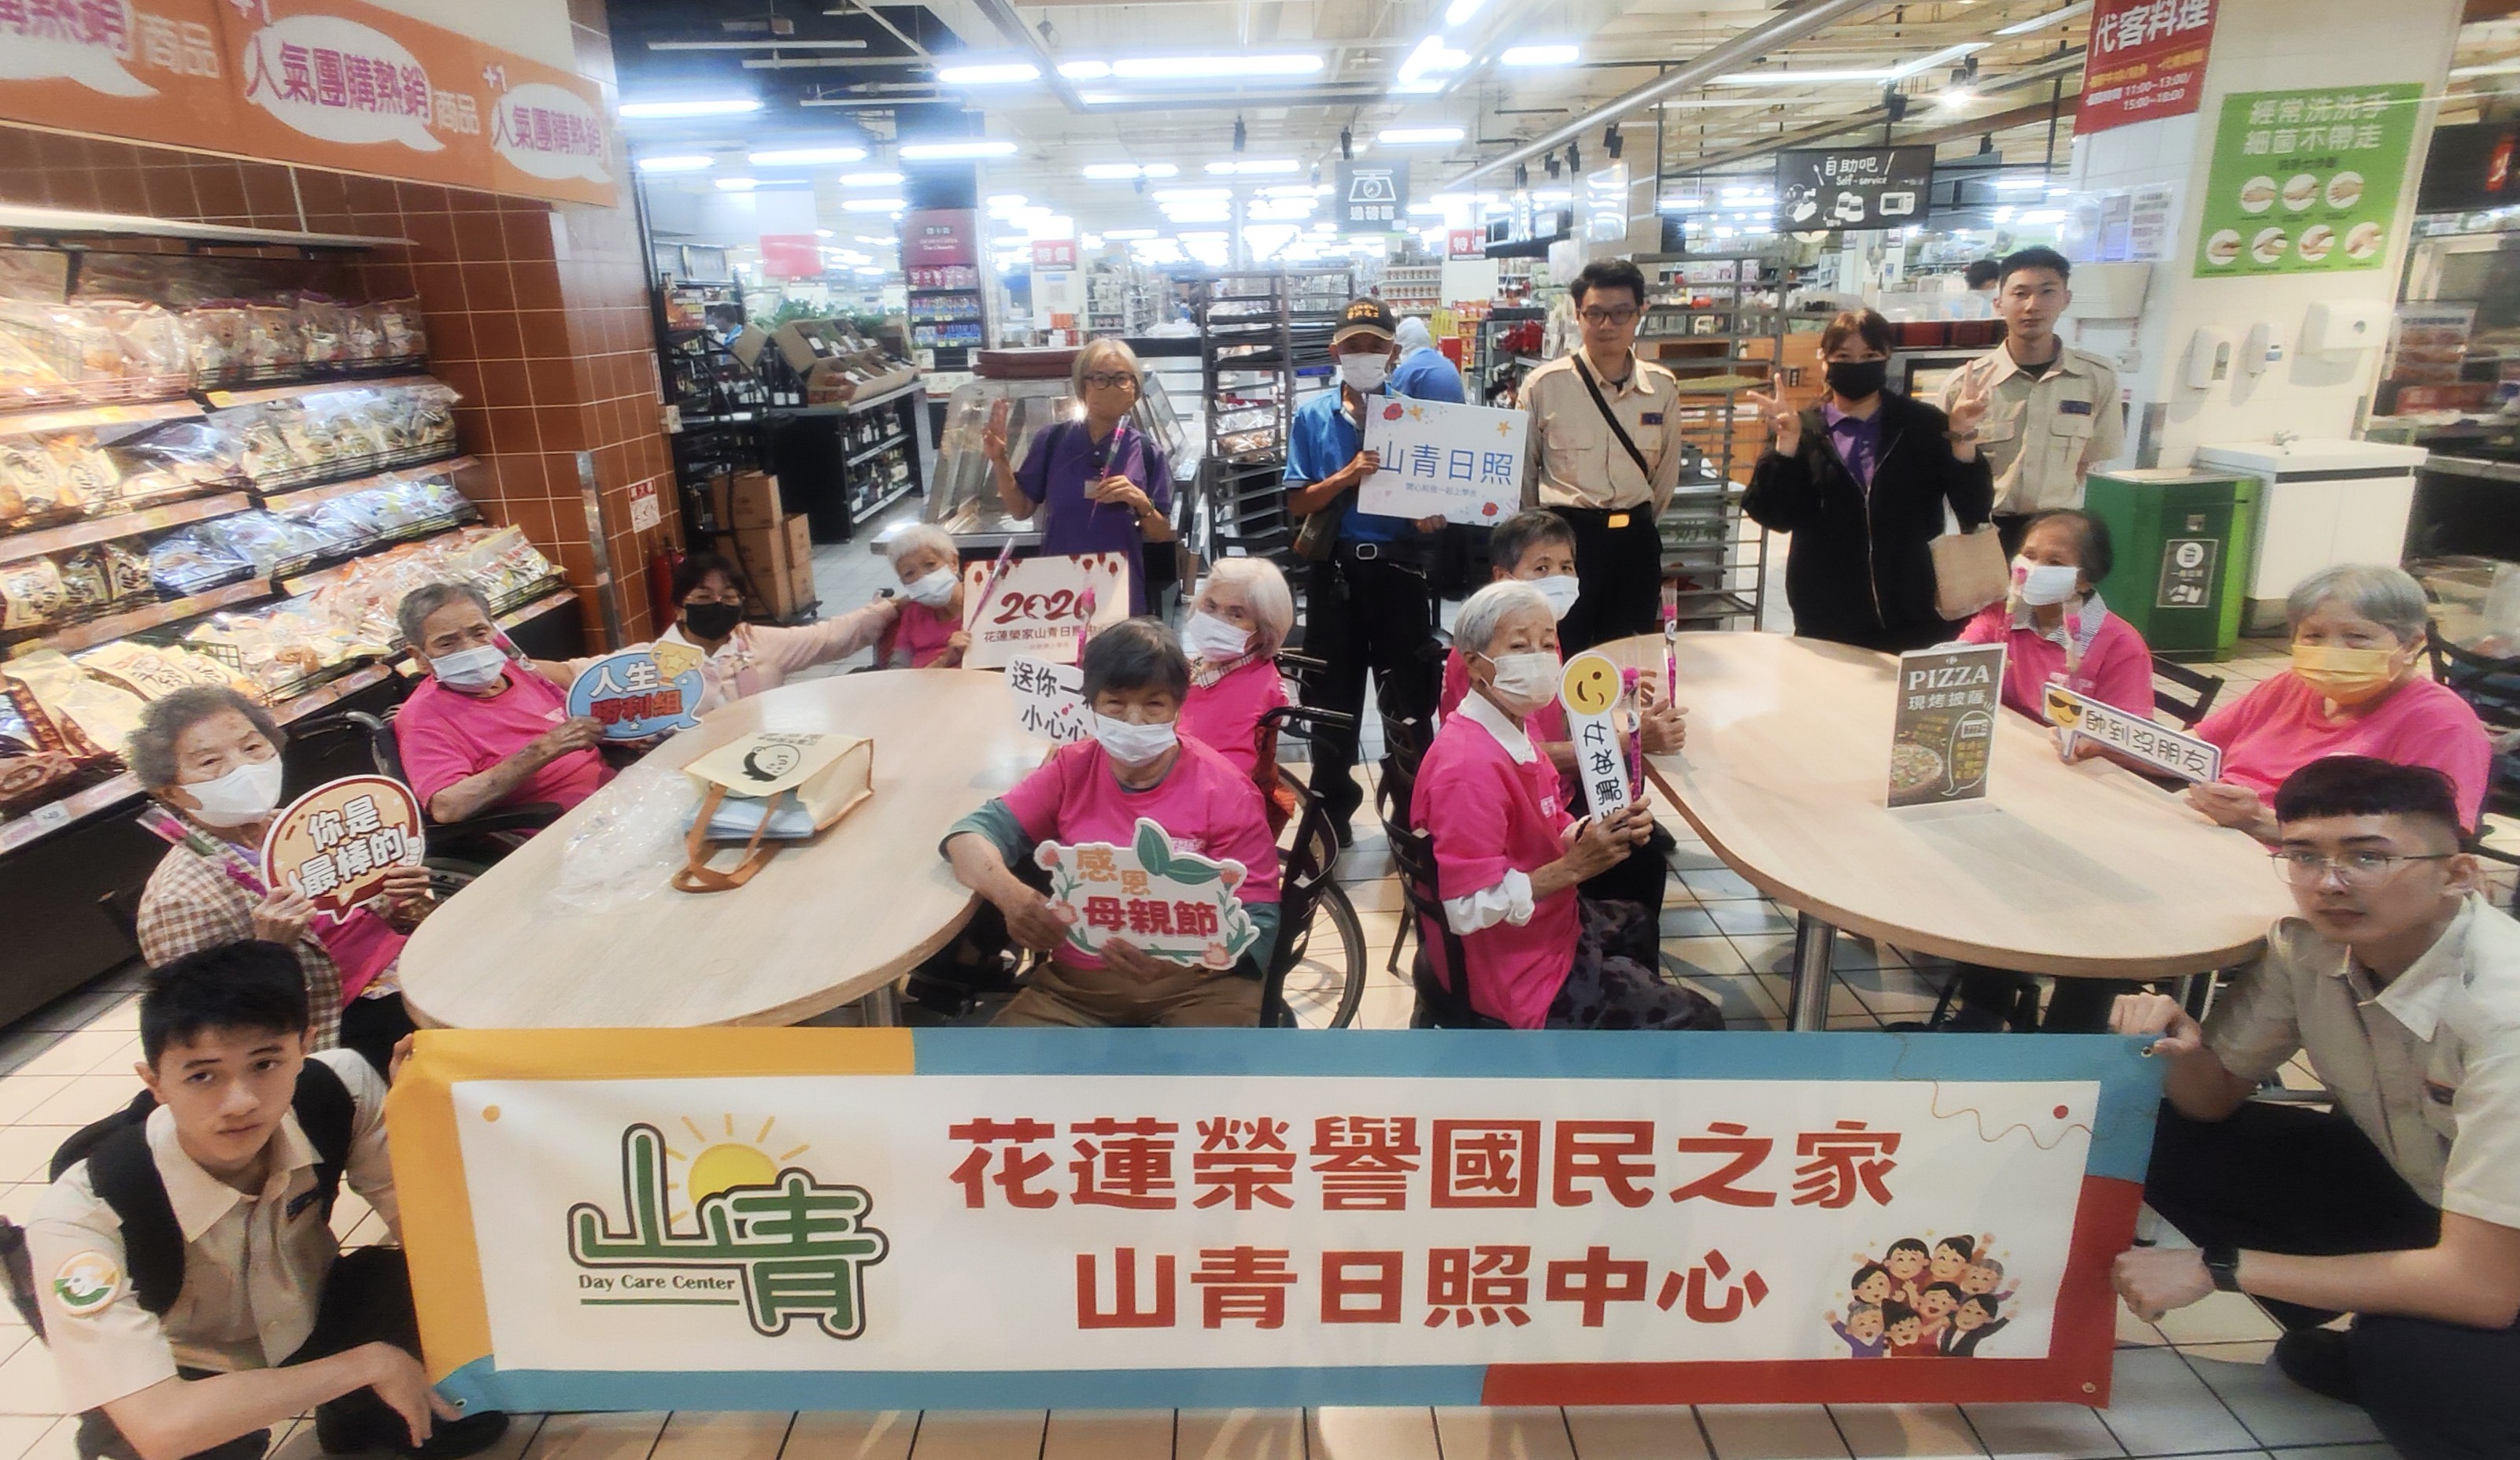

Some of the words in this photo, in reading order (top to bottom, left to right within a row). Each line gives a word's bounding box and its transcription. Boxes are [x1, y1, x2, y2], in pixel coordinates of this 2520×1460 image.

[137, 12, 220, 79] 商品
[2093, 0, 2211, 57] 代客料理
[246, 35, 430, 118] 人氣團購熱銷
[434, 89, 480, 135] 商品
[2248, 91, 2391, 125] 經常洗洗手
[493, 102, 601, 157] 人氣團購熱銷
[2243, 124, 2384, 155] 細菌不帶走
[1824, 156, 1879, 176] 自助吧
[1376, 440, 1513, 486] 山青日照
[589, 660, 660, 697] 人生
[1011, 660, 1092, 707] 送你一
[1907, 664, 1991, 691] PIZZA
[1907, 689, 1986, 711] 現烤披薩
[590, 689, 683, 726] 勝利組
[1021, 704, 1088, 742] 小心心
[2086, 710, 2209, 778] 帥到沒朋友
[307, 794, 383, 853] 你是
[299, 826, 405, 900] 最棒的
[1076, 847, 1152, 896] 感恩
[1081, 896, 1219, 937] 母親節
[948, 1115, 1903, 1211] 花蓮榮譽國民之家
[568, 1123, 889, 1339] 山青
[578, 1274, 614, 1292] Day
[620, 1274, 667, 1289] Care
[671, 1274, 737, 1292] Center
[1077, 1246, 1770, 1329] 山青日照中心
